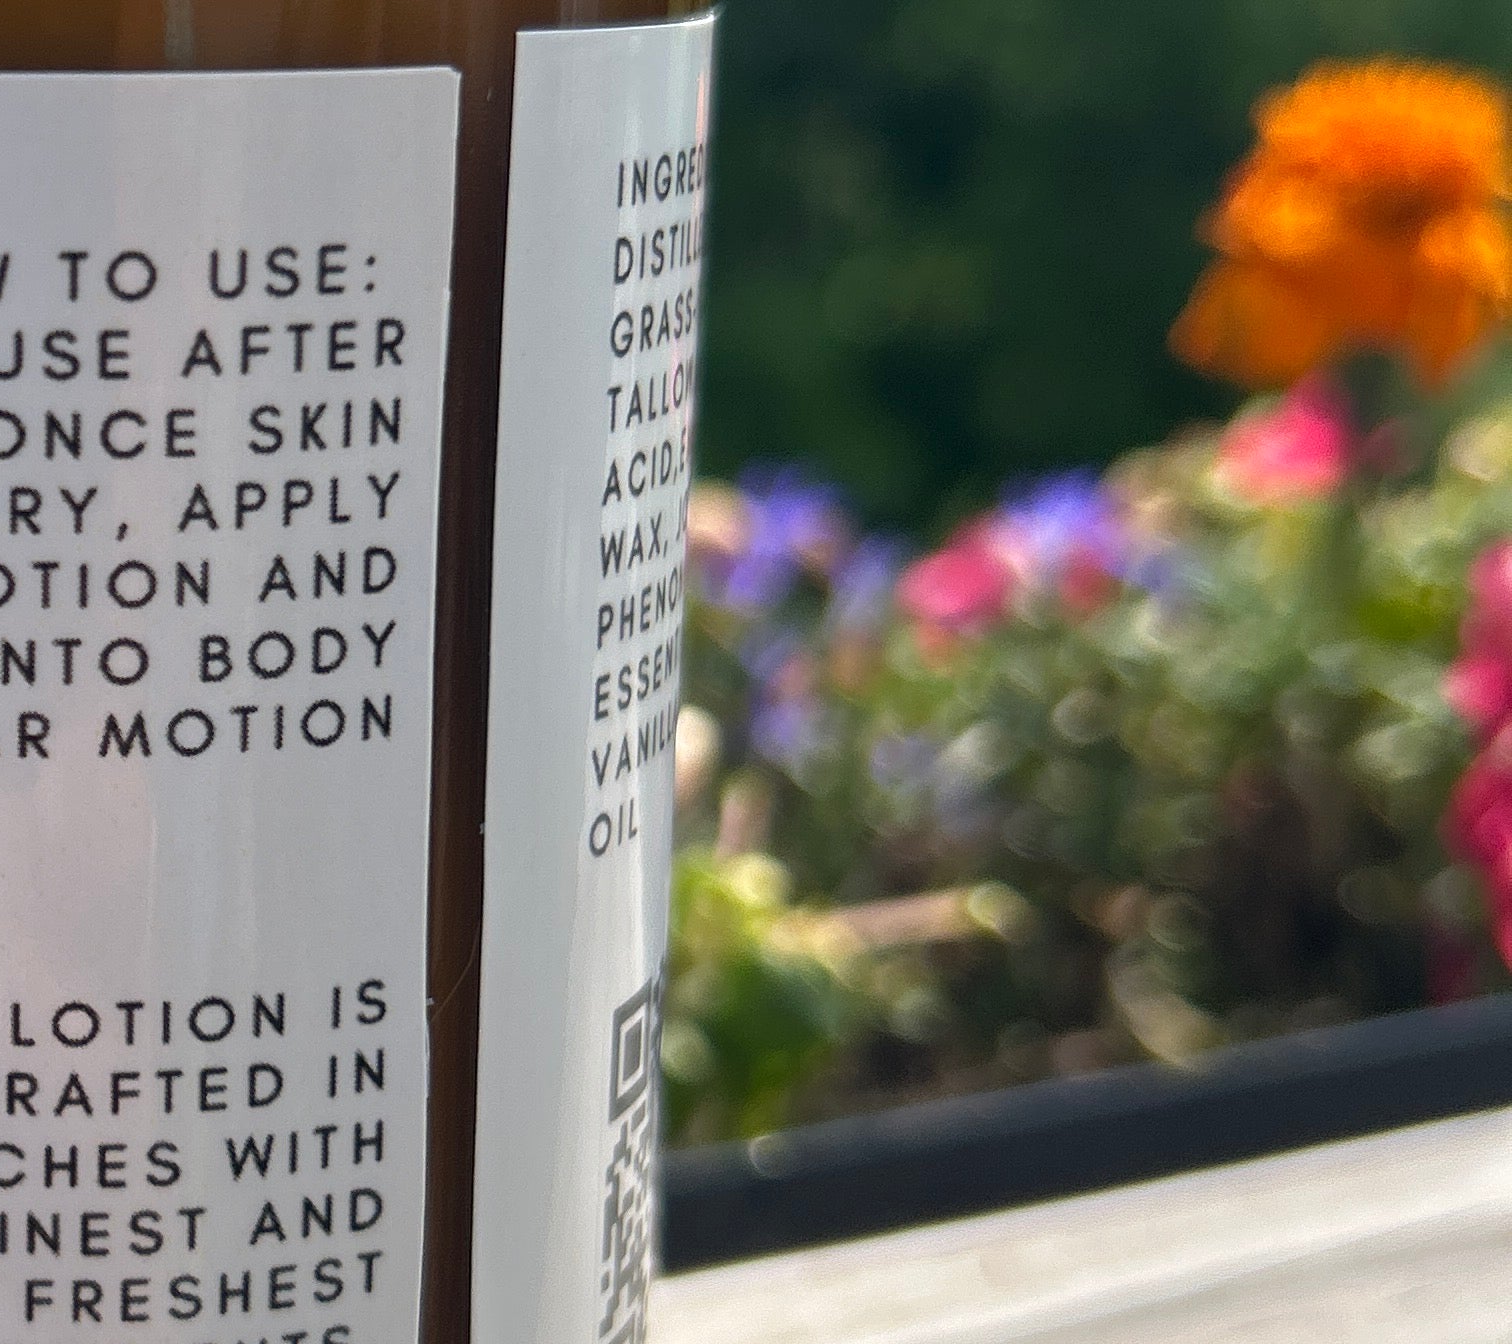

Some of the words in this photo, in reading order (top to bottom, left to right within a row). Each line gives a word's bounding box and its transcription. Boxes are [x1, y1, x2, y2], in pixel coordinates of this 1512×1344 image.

[58, 250, 158, 303] TO
[208, 243, 376, 300] USE:
[180, 317, 406, 378] AFTER
[248, 397, 401, 456] SKIN
[177, 471, 400, 533] APPLY
[258, 546, 397, 603] AND
[600, 513, 668, 578] WAX,
[597, 564, 683, 650] PHENO
[199, 620, 396, 683] BODY
[98, 694, 392, 758] MOTION
[592, 698, 678, 787] VANILL
[589, 800, 638, 857] OIL
[10, 992, 285, 1049] LOTION
[331, 978, 387, 1029] IS
[328, 1048, 385, 1099] IN
[225, 1119, 384, 1182] WITH
[249, 1188, 384, 1245] AND
[24, 1250, 383, 1323] FRESHEST
